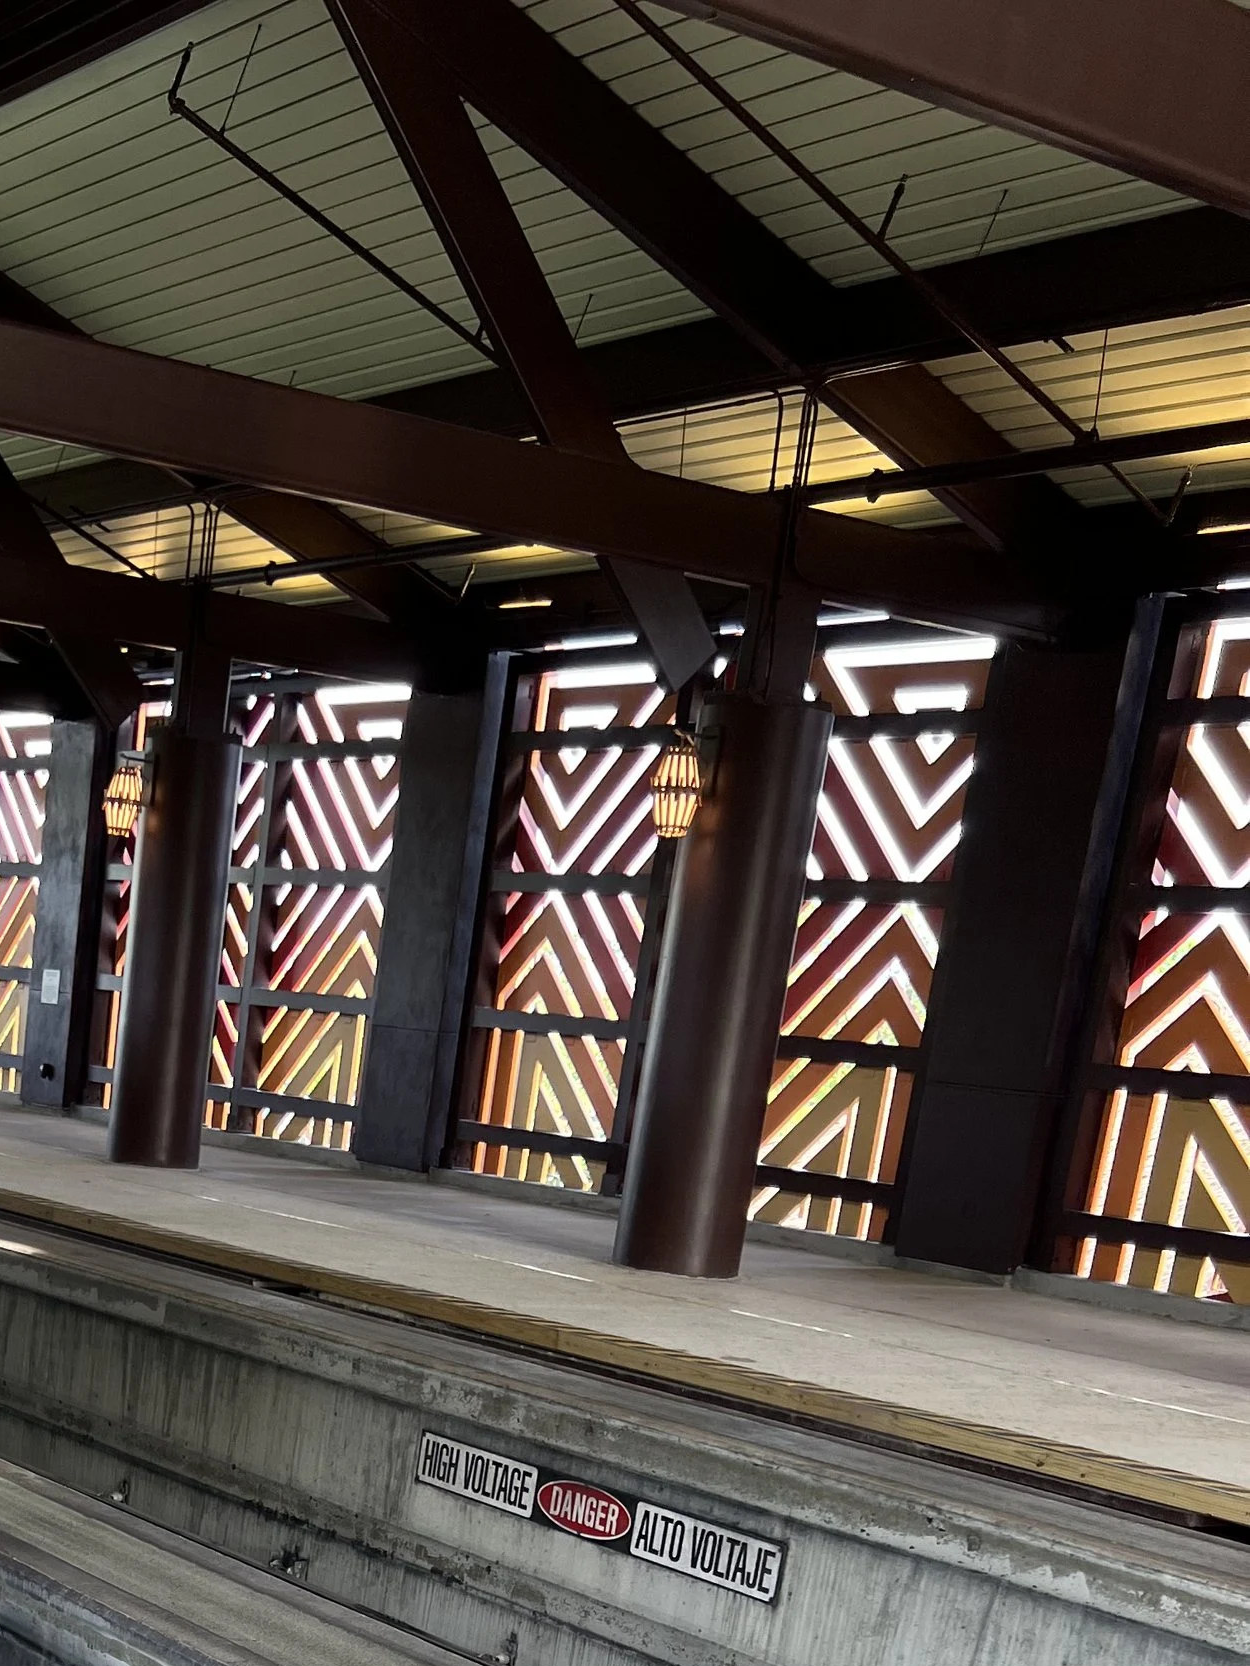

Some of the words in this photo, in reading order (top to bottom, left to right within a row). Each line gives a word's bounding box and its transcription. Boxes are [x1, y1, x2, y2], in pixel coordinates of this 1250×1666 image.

[422, 1438, 460, 1486] HIGH
[463, 1451, 533, 1511] VOLTAGE
[549, 1485, 620, 1536] DANGER
[634, 1509, 685, 1563] ALTO
[689, 1525, 777, 1594] VOLTAJE
